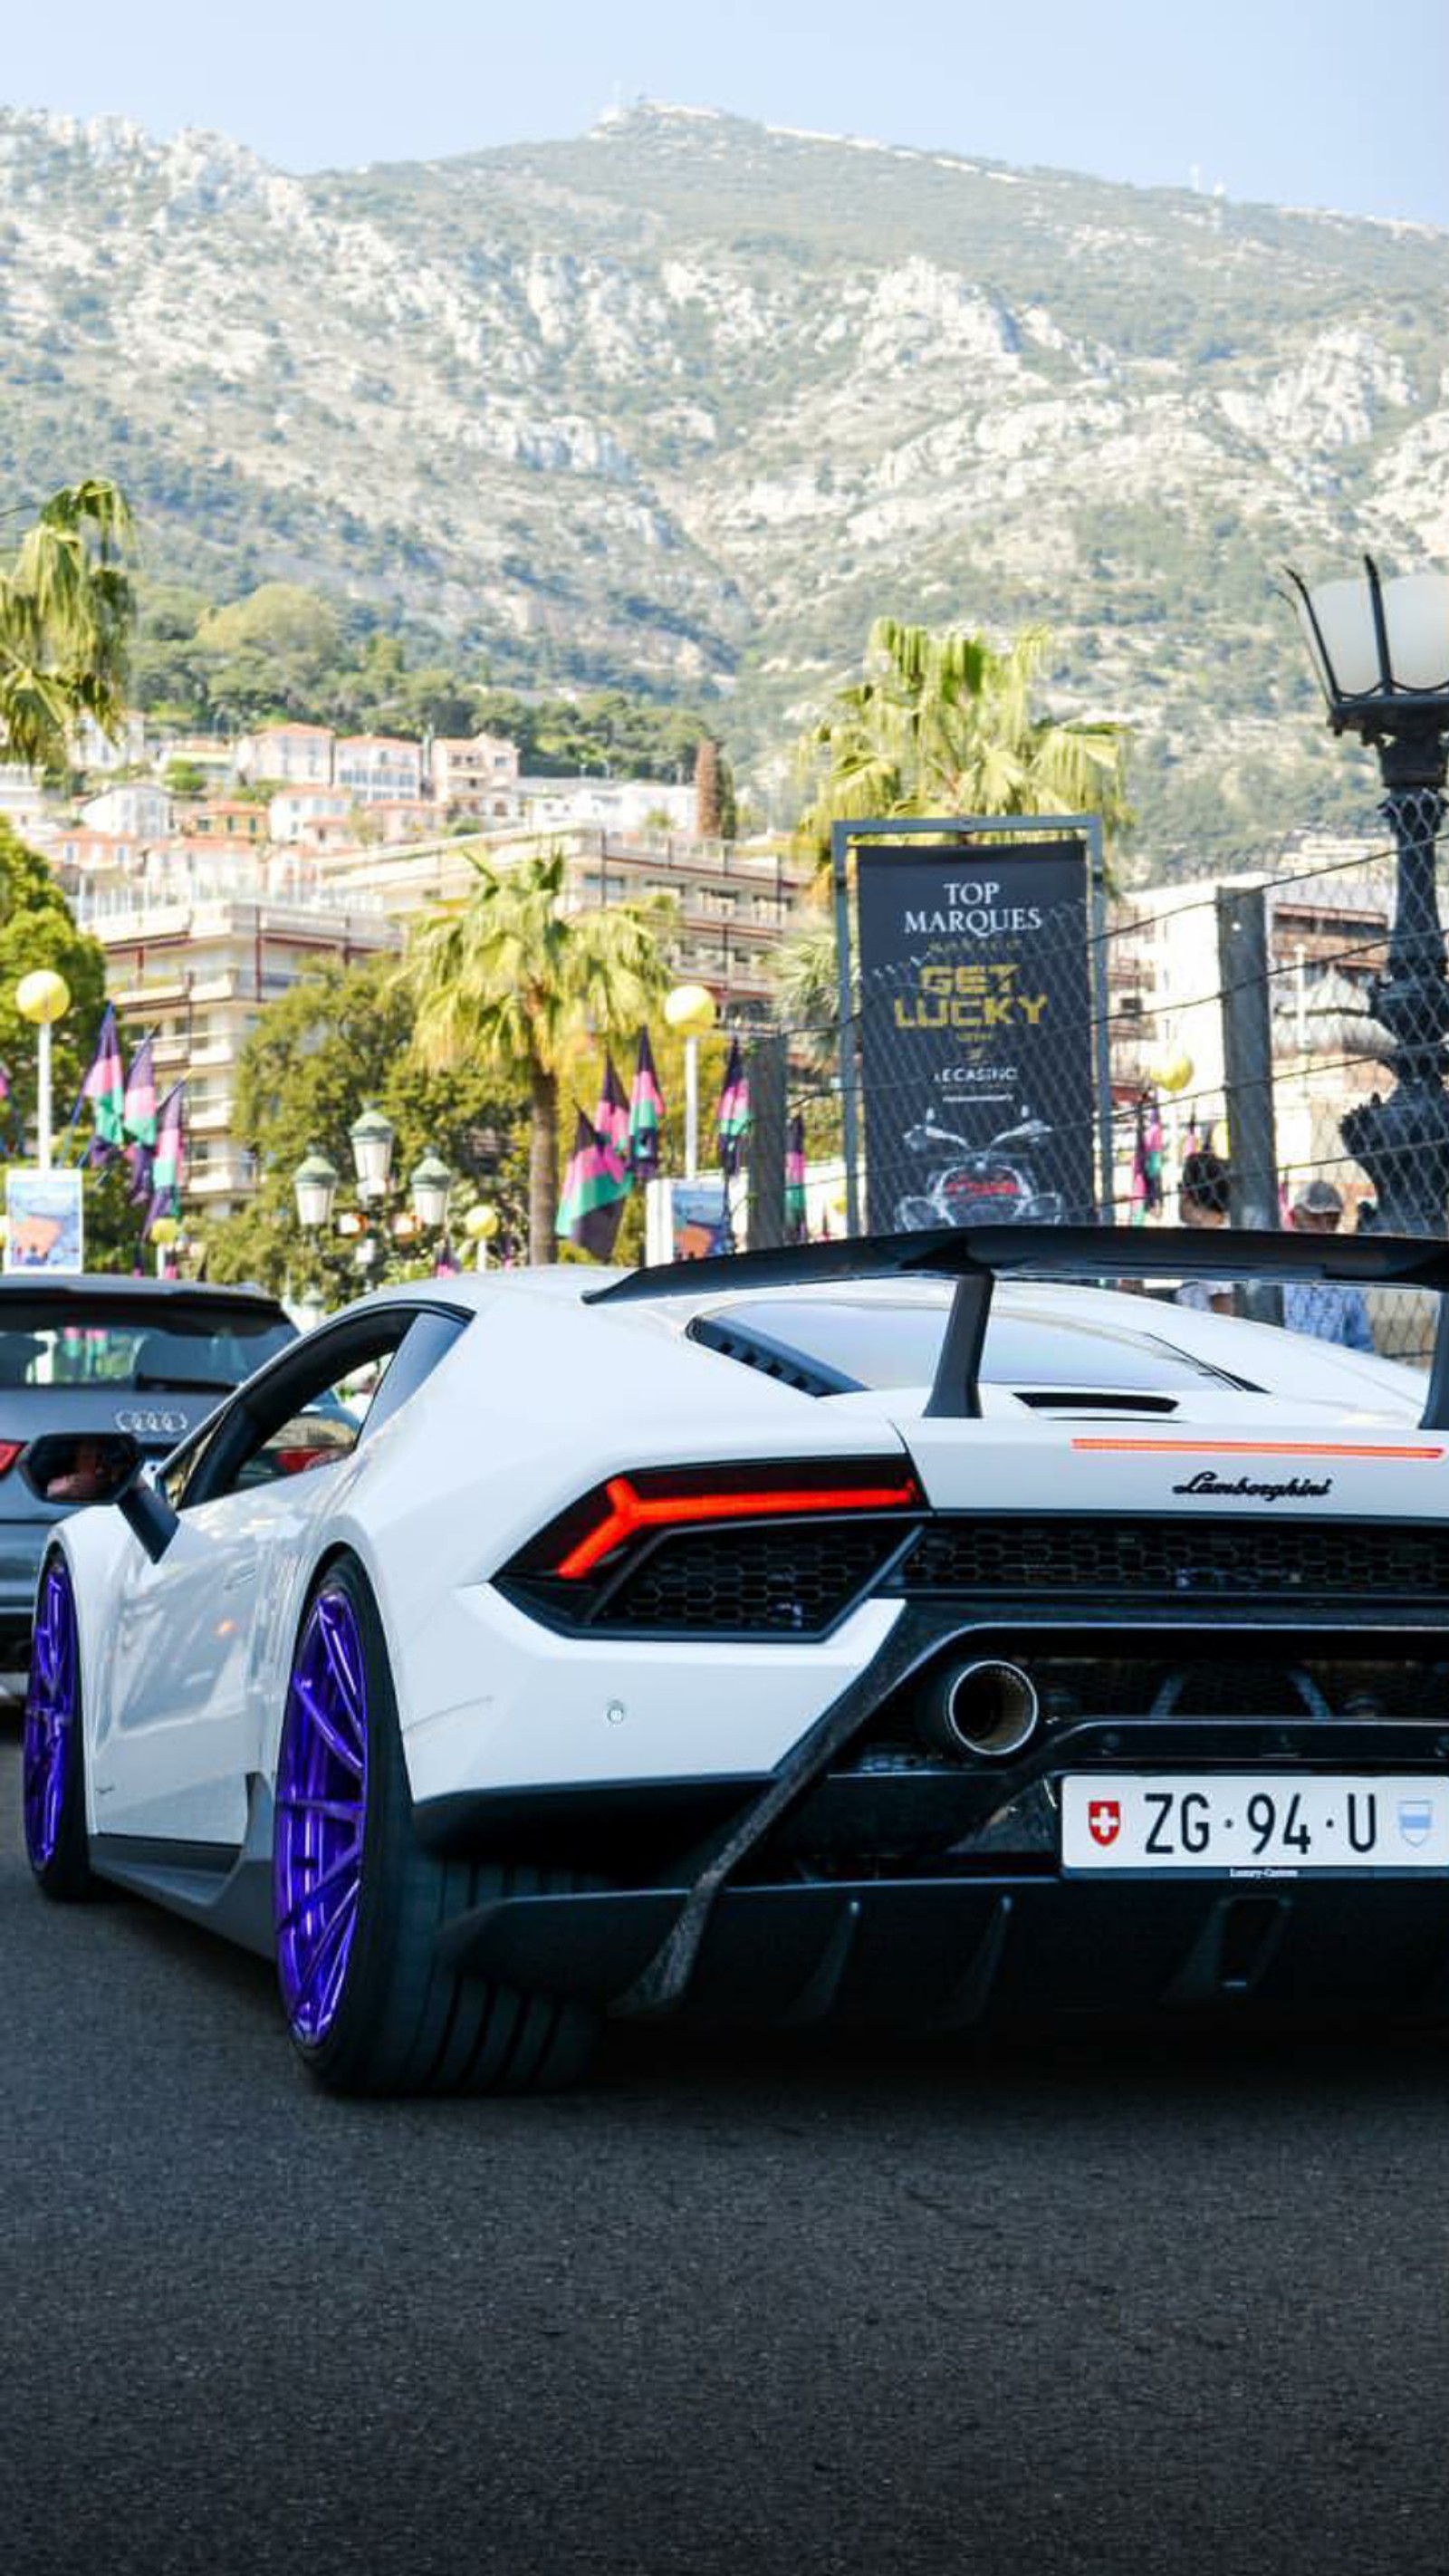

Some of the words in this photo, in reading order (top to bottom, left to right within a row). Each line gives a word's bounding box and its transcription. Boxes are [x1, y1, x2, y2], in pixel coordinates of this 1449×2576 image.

[943, 881, 1000, 905] TOP
[904, 908, 1042, 937] MARQUES
[920, 964, 1021, 995] GET
[894, 994, 1048, 1027] LUCKY
[1173, 1471, 1332, 1502] Lamborghini
